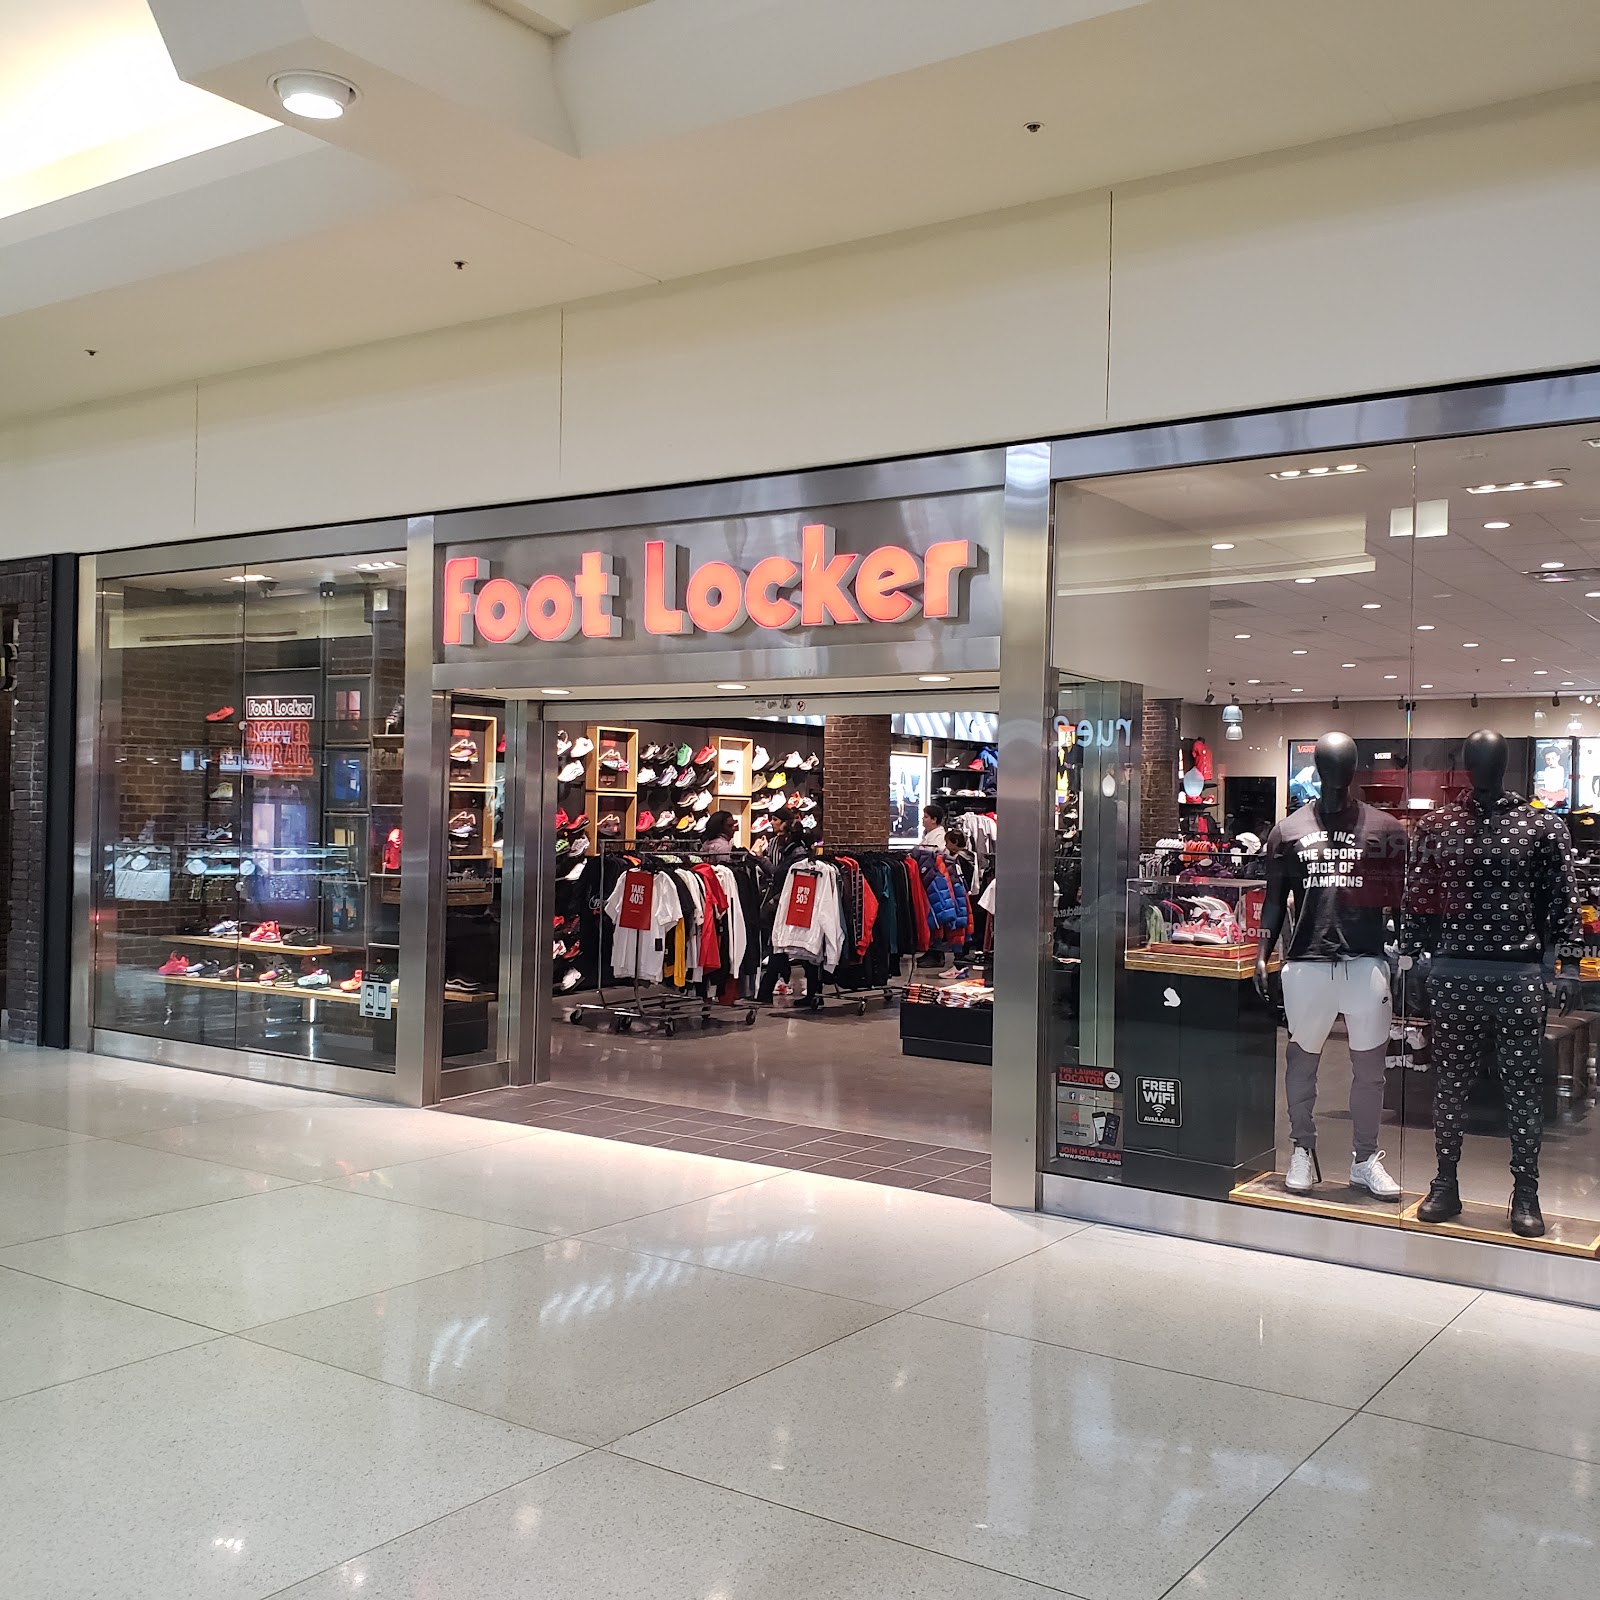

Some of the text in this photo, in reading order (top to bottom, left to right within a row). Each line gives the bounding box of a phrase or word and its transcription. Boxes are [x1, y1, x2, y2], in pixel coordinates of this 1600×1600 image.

[443, 524, 977, 645] Foot Locker
[248, 699, 312, 716] Foot Locker
[246, 721, 310, 743] DISCOVER
[1297, 745, 1316, 753] VANS
[1374, 752, 1392, 760] VANS
[1300, 831, 1356, 848] NIKE INC.
[1297, 849, 1318, 862] THE
[1323, 848, 1363, 861] SPORT
[1306, 862, 1354, 874] SHOE OF
[631, 884, 645, 894] TAKE
[1555, 943, 1600, 958] footl
[1074, 1068, 1104, 1077] LAUNCH
[1059, 1073, 1104, 1085] LOCATOR
[1142, 1080, 1175, 1092] FREE
[1143, 1116, 1176, 1125] AVAILABLE
[1061, 1146, 1078, 1154] JOIN
[1079, 1148, 1096, 1157] OUR
